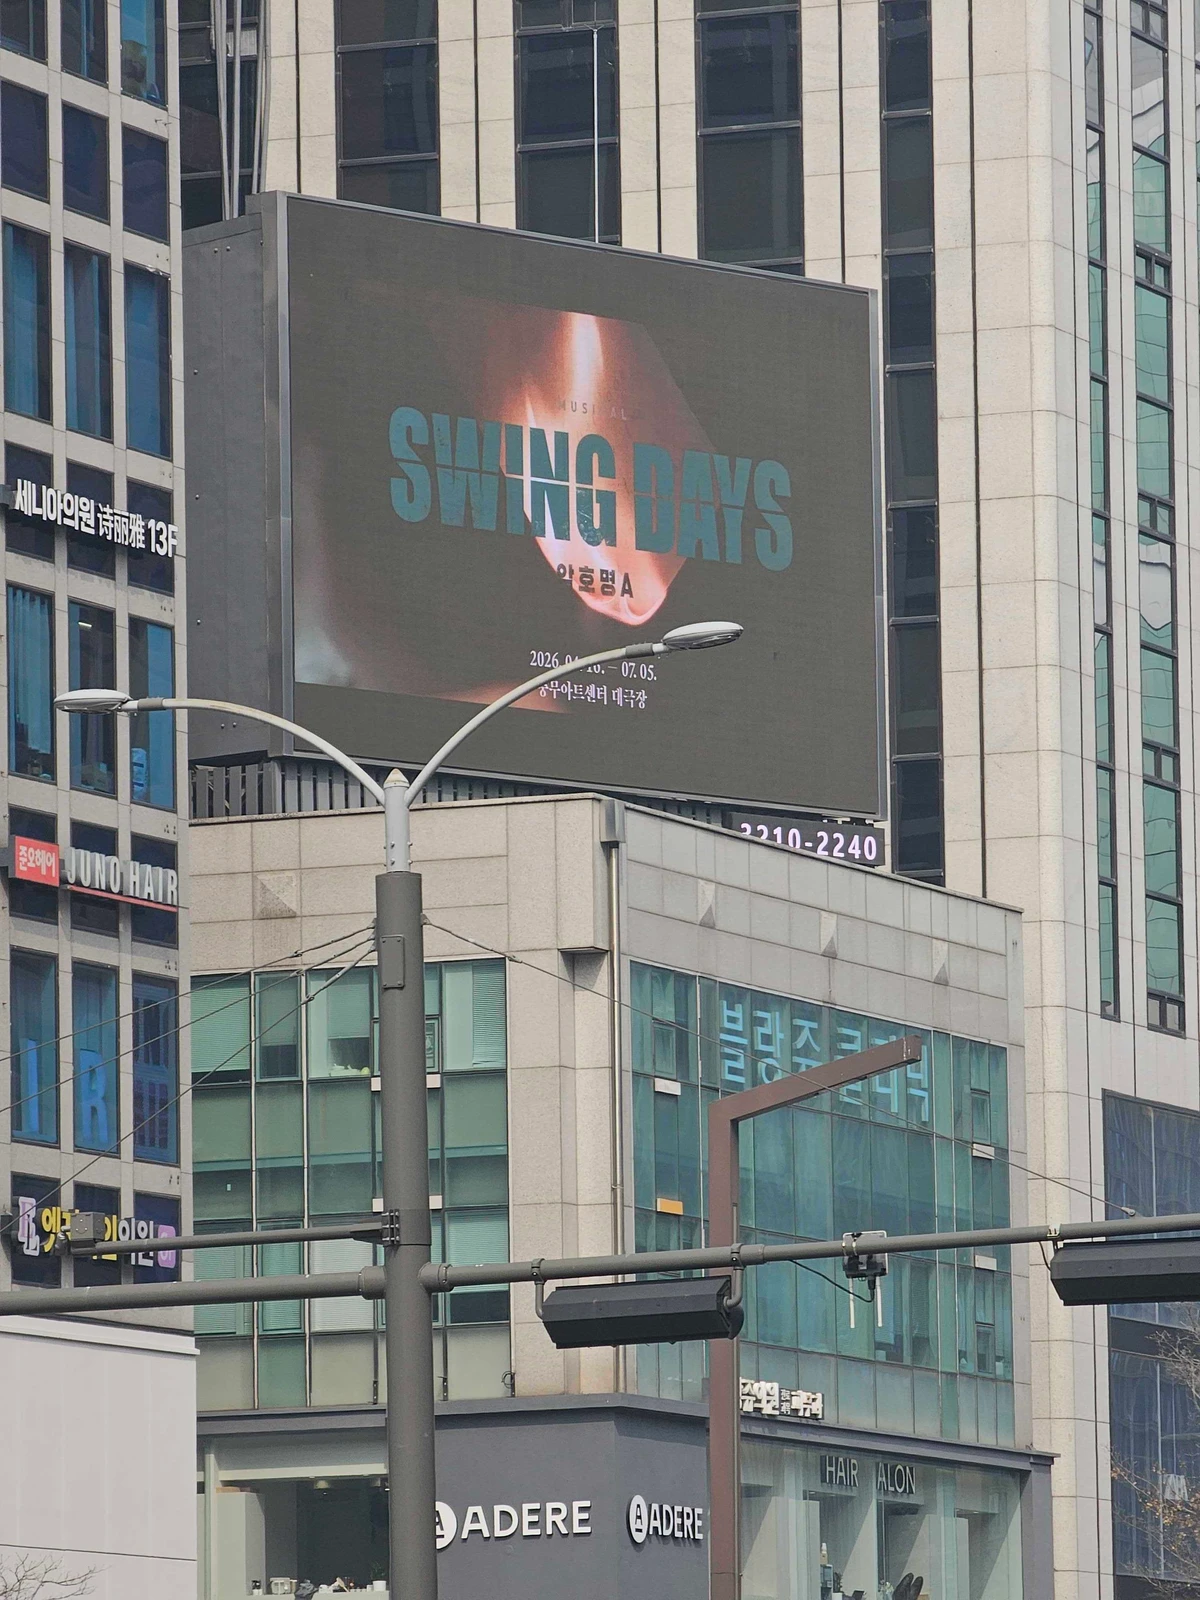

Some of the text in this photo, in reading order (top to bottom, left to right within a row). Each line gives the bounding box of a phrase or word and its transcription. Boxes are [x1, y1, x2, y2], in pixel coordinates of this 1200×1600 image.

[388, 406, 793, 572] SWING DAYS
[14, 478, 179, 558] 세니아의원 诗丽雅 13F
[612, 686, 648, 709] 대극장
[18, 845, 56, 878] 준오헤어
[66, 847, 178, 906] JUNO HAIR
[826, 1455, 859, 1487] HAIR
[461, 1500, 592, 1540] ADERE
[648, 1502, 704, 1540] ADERE
